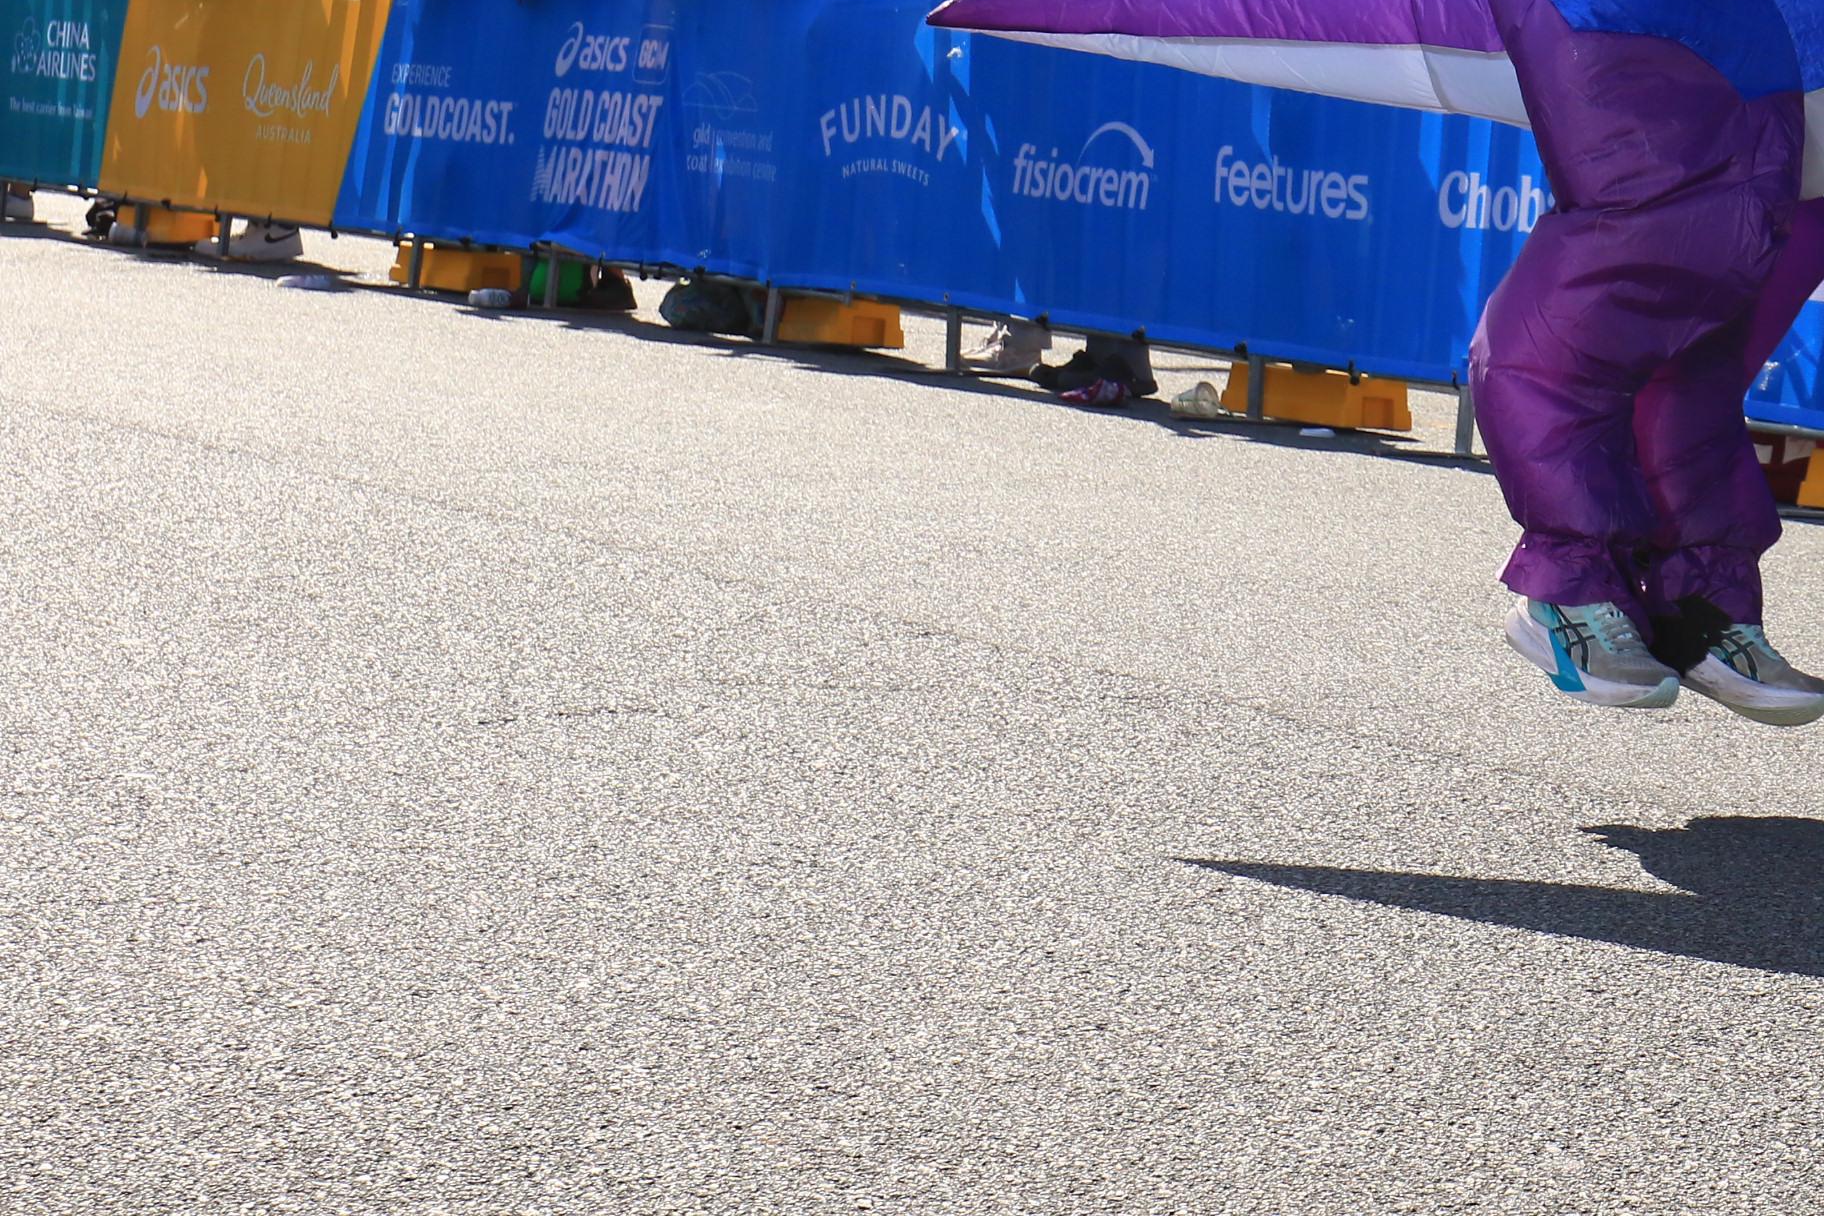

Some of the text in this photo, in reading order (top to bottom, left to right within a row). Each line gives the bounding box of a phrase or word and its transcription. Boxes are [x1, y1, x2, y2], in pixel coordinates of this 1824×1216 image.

[46, 20, 90, 50] CHINA
[578, 35, 631, 72] asics
[36, 50, 97, 82] AIRLINES
[158, 63, 210, 114] asics
[243, 52, 340, 118] Queensland
[391, 63, 453, 87] EXPERIENCE
[256, 124, 312, 145] AUSTRALIA
[384, 92, 516, 146] GOLDCOAST.
[543, 87, 664, 148] GOLD COAST
[819, 93, 960, 162] FUNDAY
[530, 144, 651, 213] MARATHON
[841, 157, 931, 187] NATURAL SWEETS
[1012, 142, 1150, 211] fisiocrem
[1213, 144, 1369, 221] feetures
[1438, 170, 1556, 234] Chob
